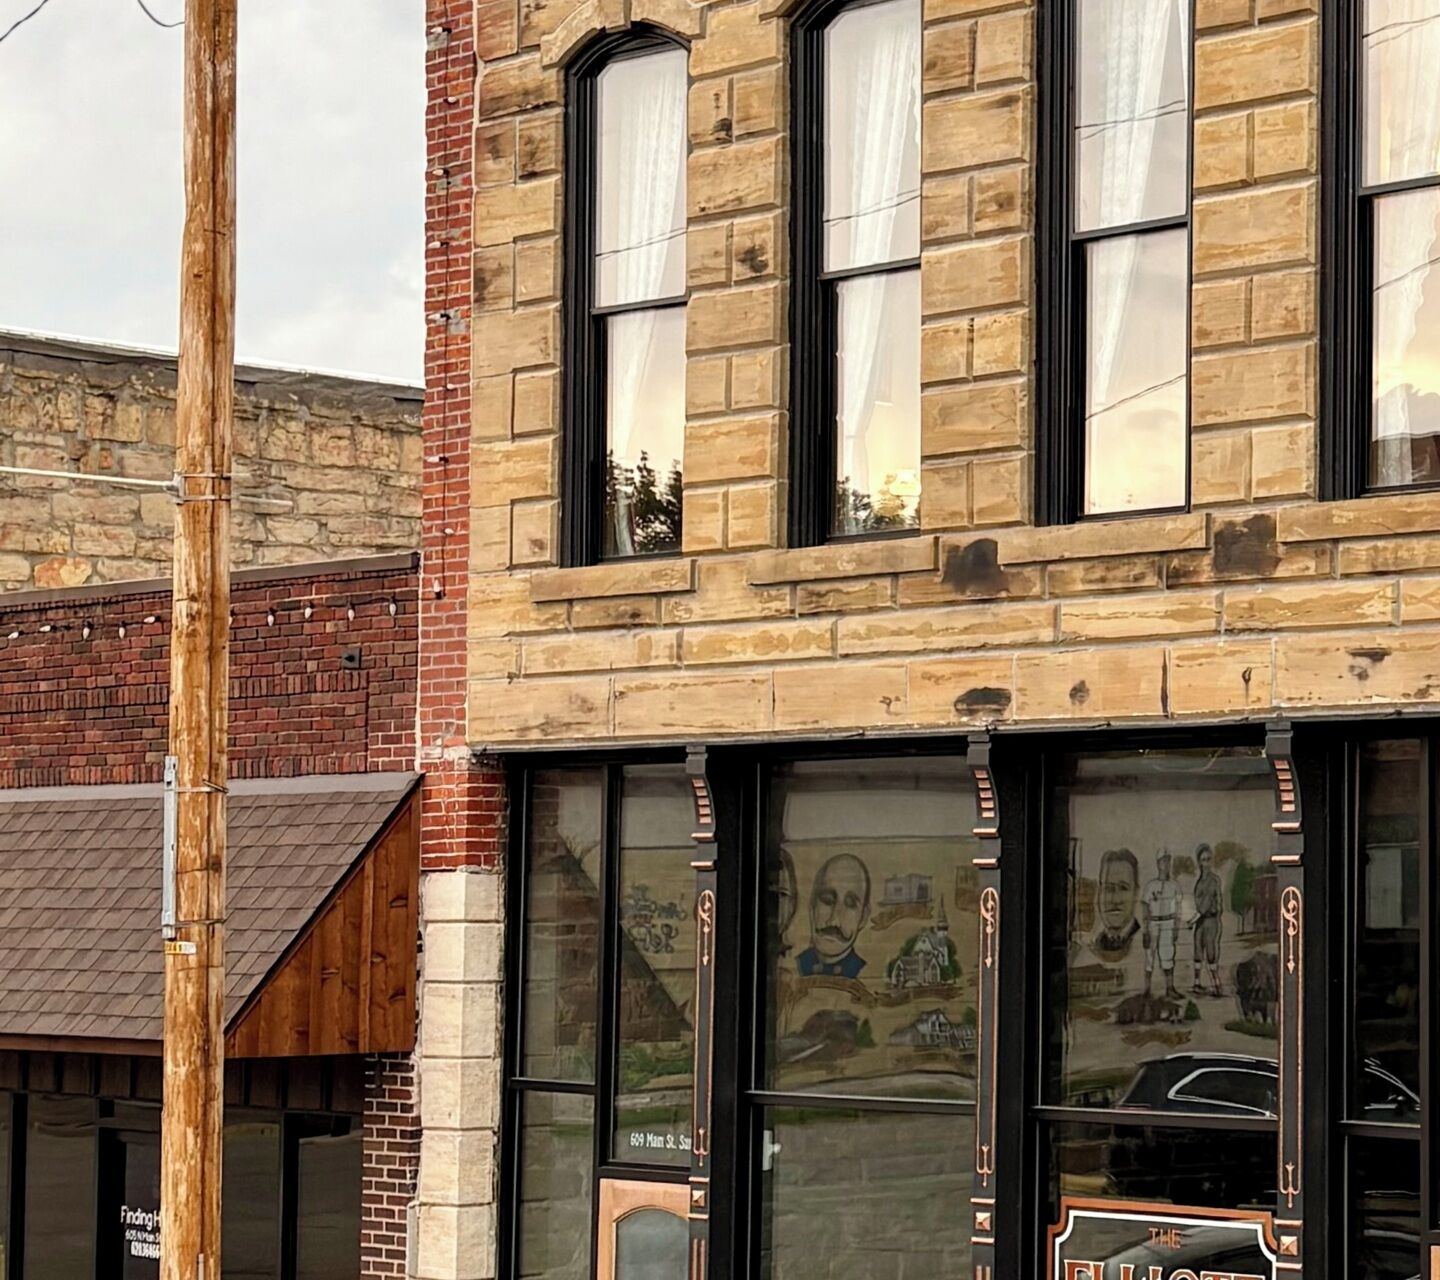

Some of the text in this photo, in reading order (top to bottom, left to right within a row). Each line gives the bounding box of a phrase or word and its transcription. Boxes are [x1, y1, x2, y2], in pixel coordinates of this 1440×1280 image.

[646, 1132, 664, 1148] Main
[120, 1205, 152, 1231] Finding
[1148, 1227, 1182, 1249] THE
